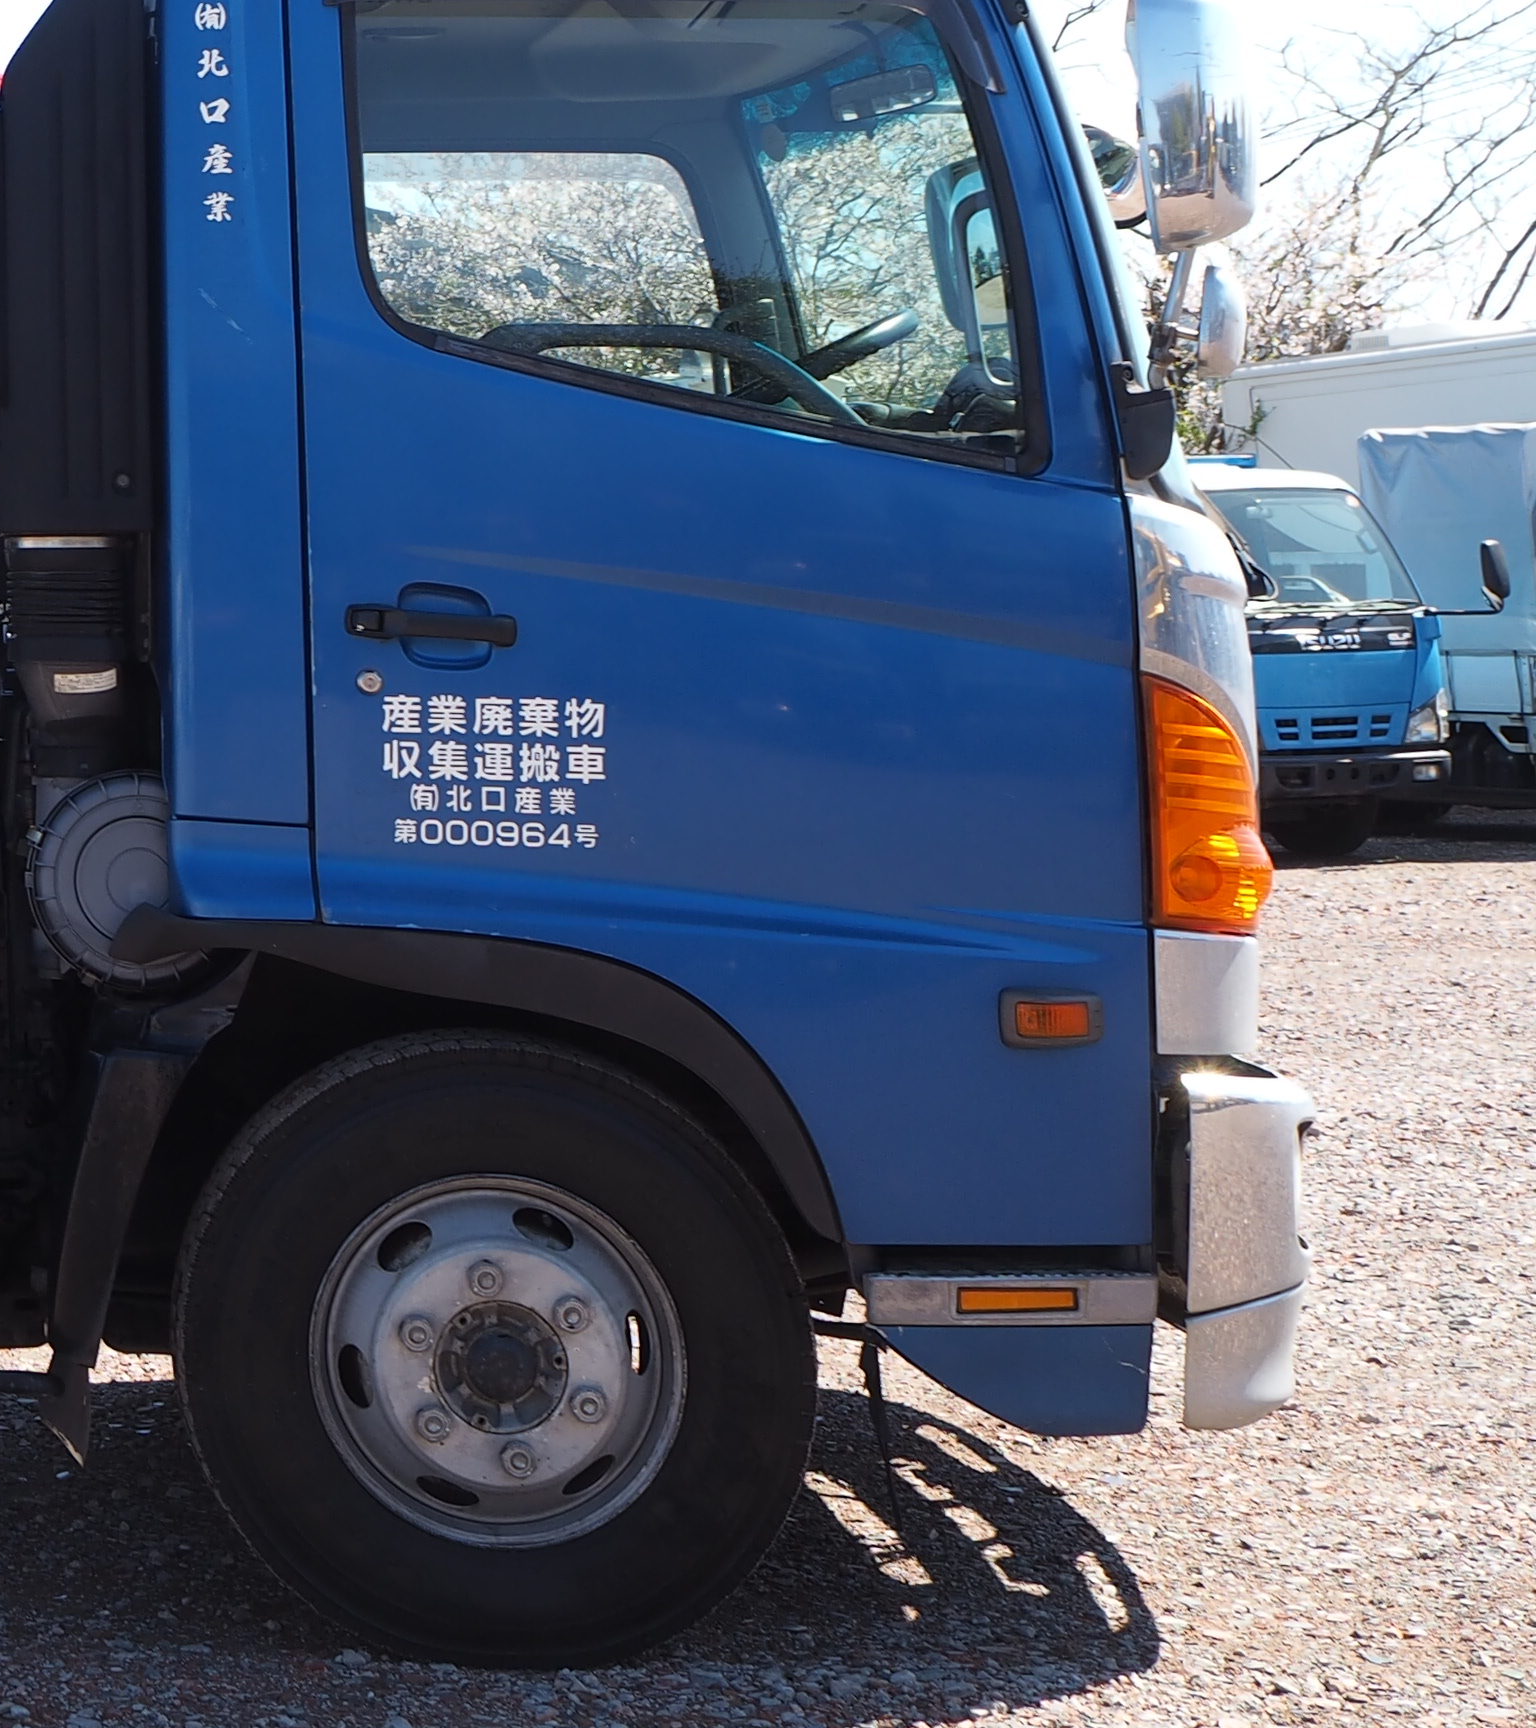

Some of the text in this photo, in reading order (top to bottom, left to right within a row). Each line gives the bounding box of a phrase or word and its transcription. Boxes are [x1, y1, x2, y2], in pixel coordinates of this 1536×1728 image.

[382, 694, 605, 738] 産業廃棄物
[383, 739, 606, 784] 収集運搬車
[394, 818, 599, 848] 第000964号
